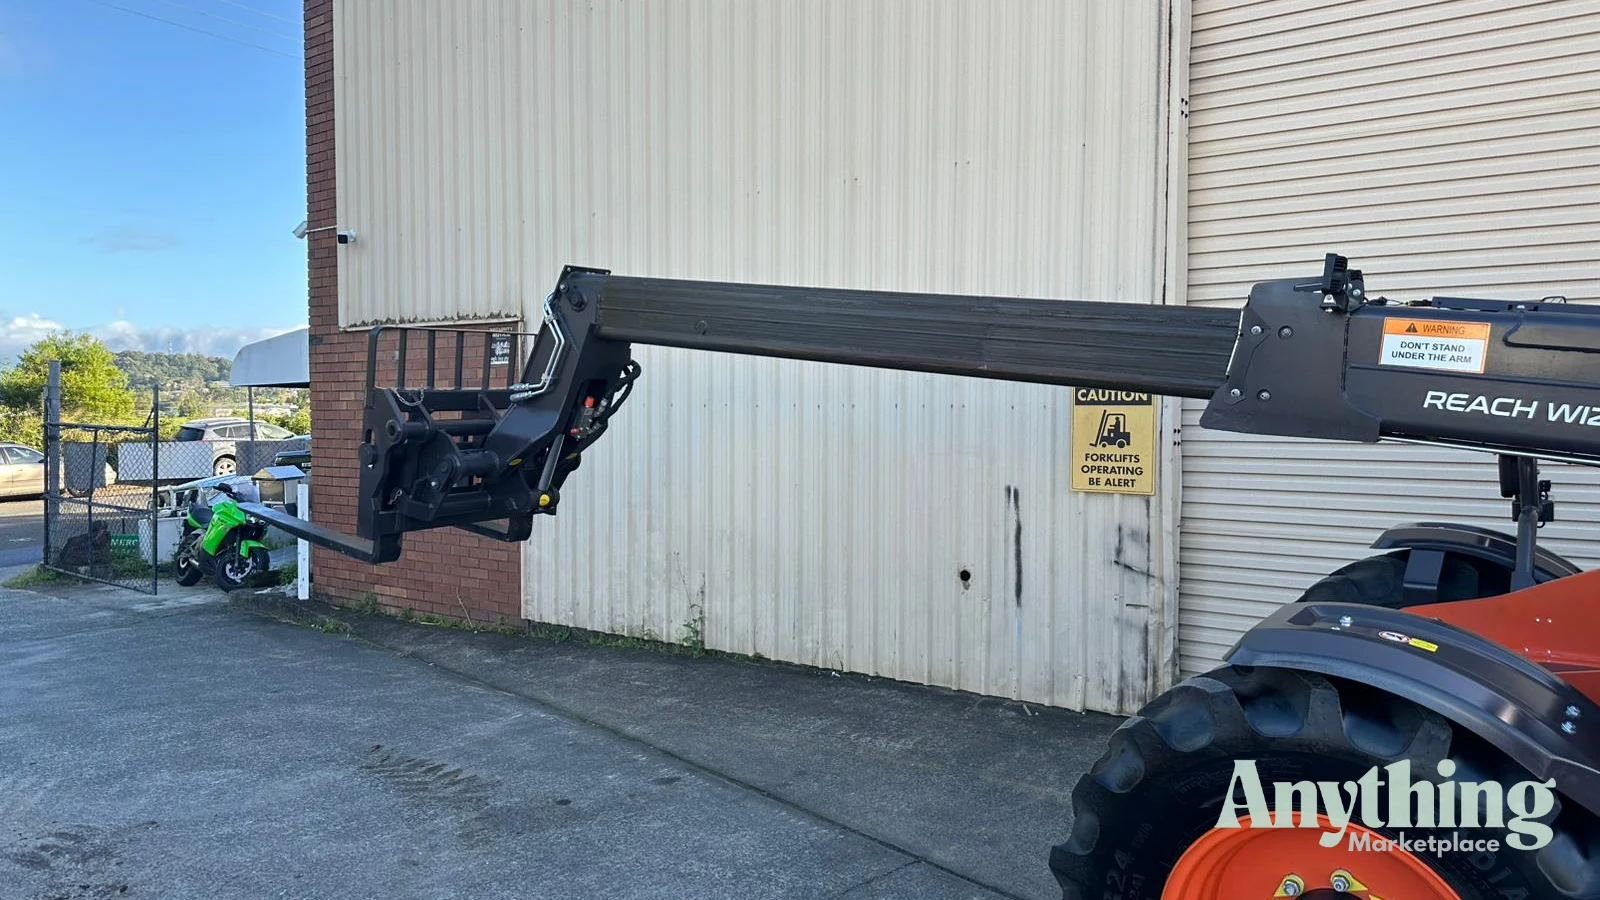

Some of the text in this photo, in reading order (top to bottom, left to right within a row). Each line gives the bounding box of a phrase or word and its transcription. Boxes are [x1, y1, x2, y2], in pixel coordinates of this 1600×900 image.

[1423, 324, 1465, 335] WARNING
[1400, 341, 1465, 353] DON'T STAND
[1391, 351, 1472, 364] UNDER THE ARM
[1077, 388, 1148, 401] CAUTION
[1423, 390, 1600, 427] REACH WIZ
[1085, 453, 1140, 463] FORKLIFTS
[1081, 465, 1144, 475] OPERATING
[1089, 477, 1137, 487] BE ALERT
